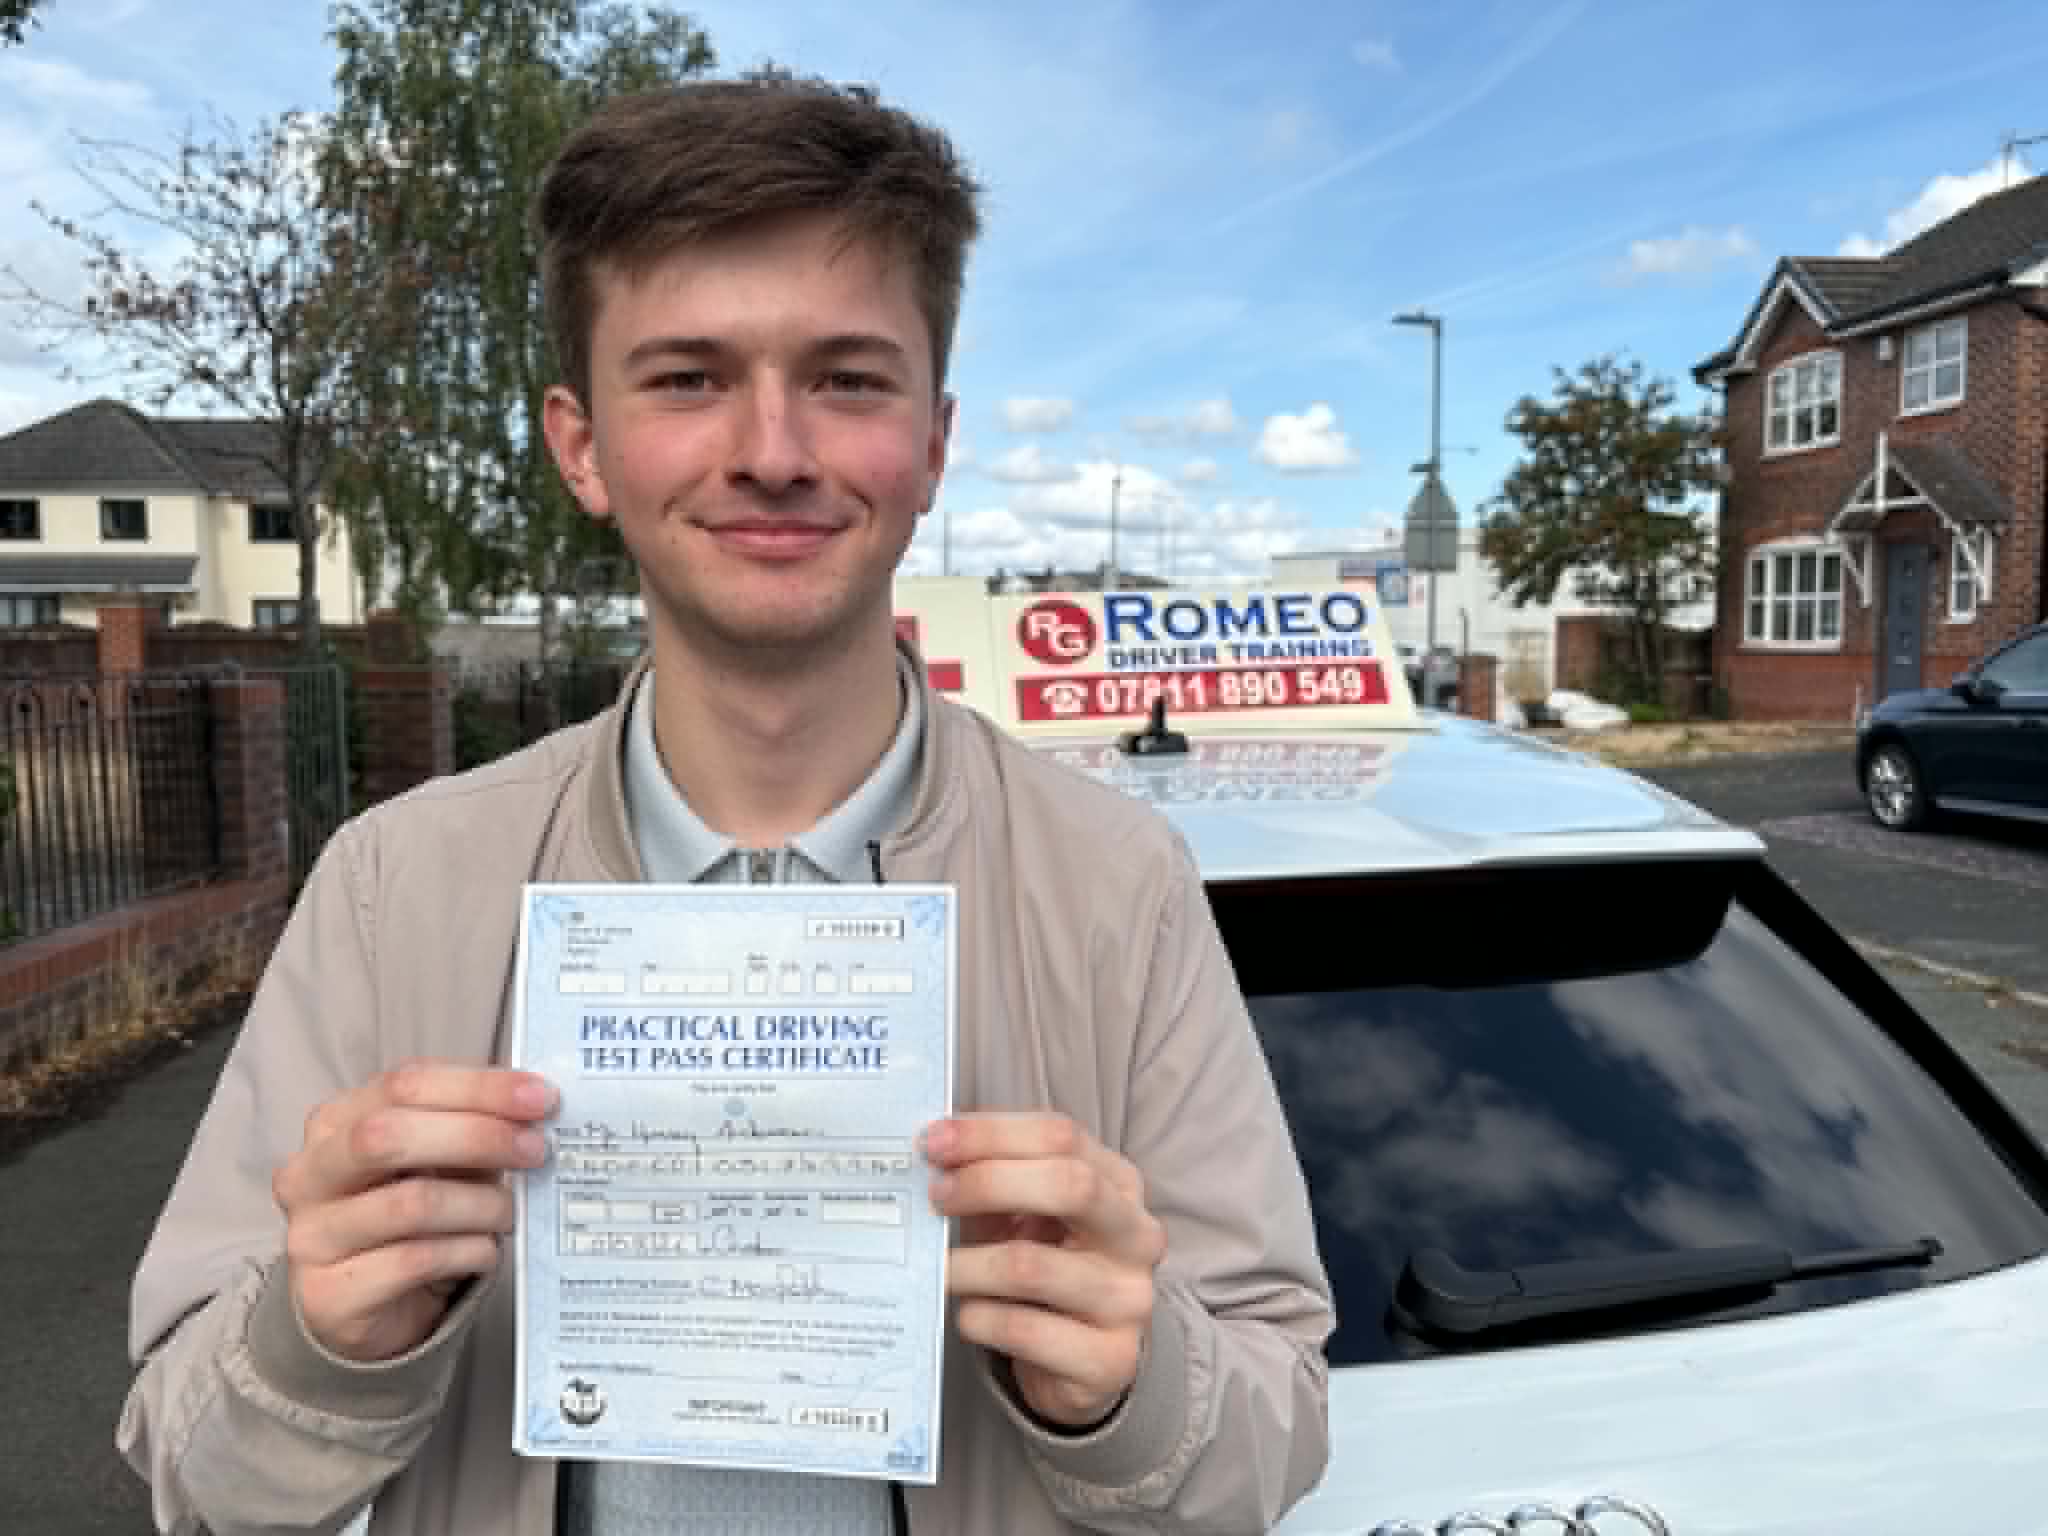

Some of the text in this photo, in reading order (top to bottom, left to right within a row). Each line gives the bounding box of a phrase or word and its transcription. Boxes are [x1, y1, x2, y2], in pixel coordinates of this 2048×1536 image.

[1104, 592, 1368, 643] ROMEO
[1109, 638, 1371, 670] DRIVER TRAINING
[1219, 670, 1287, 706] 890
[1297, 668, 1364, 702] 549
[580, 1014, 889, 1042] PRACTICAL DRIVING
[581, 1046, 888, 1072] TEST PASS CERTIFICATE
